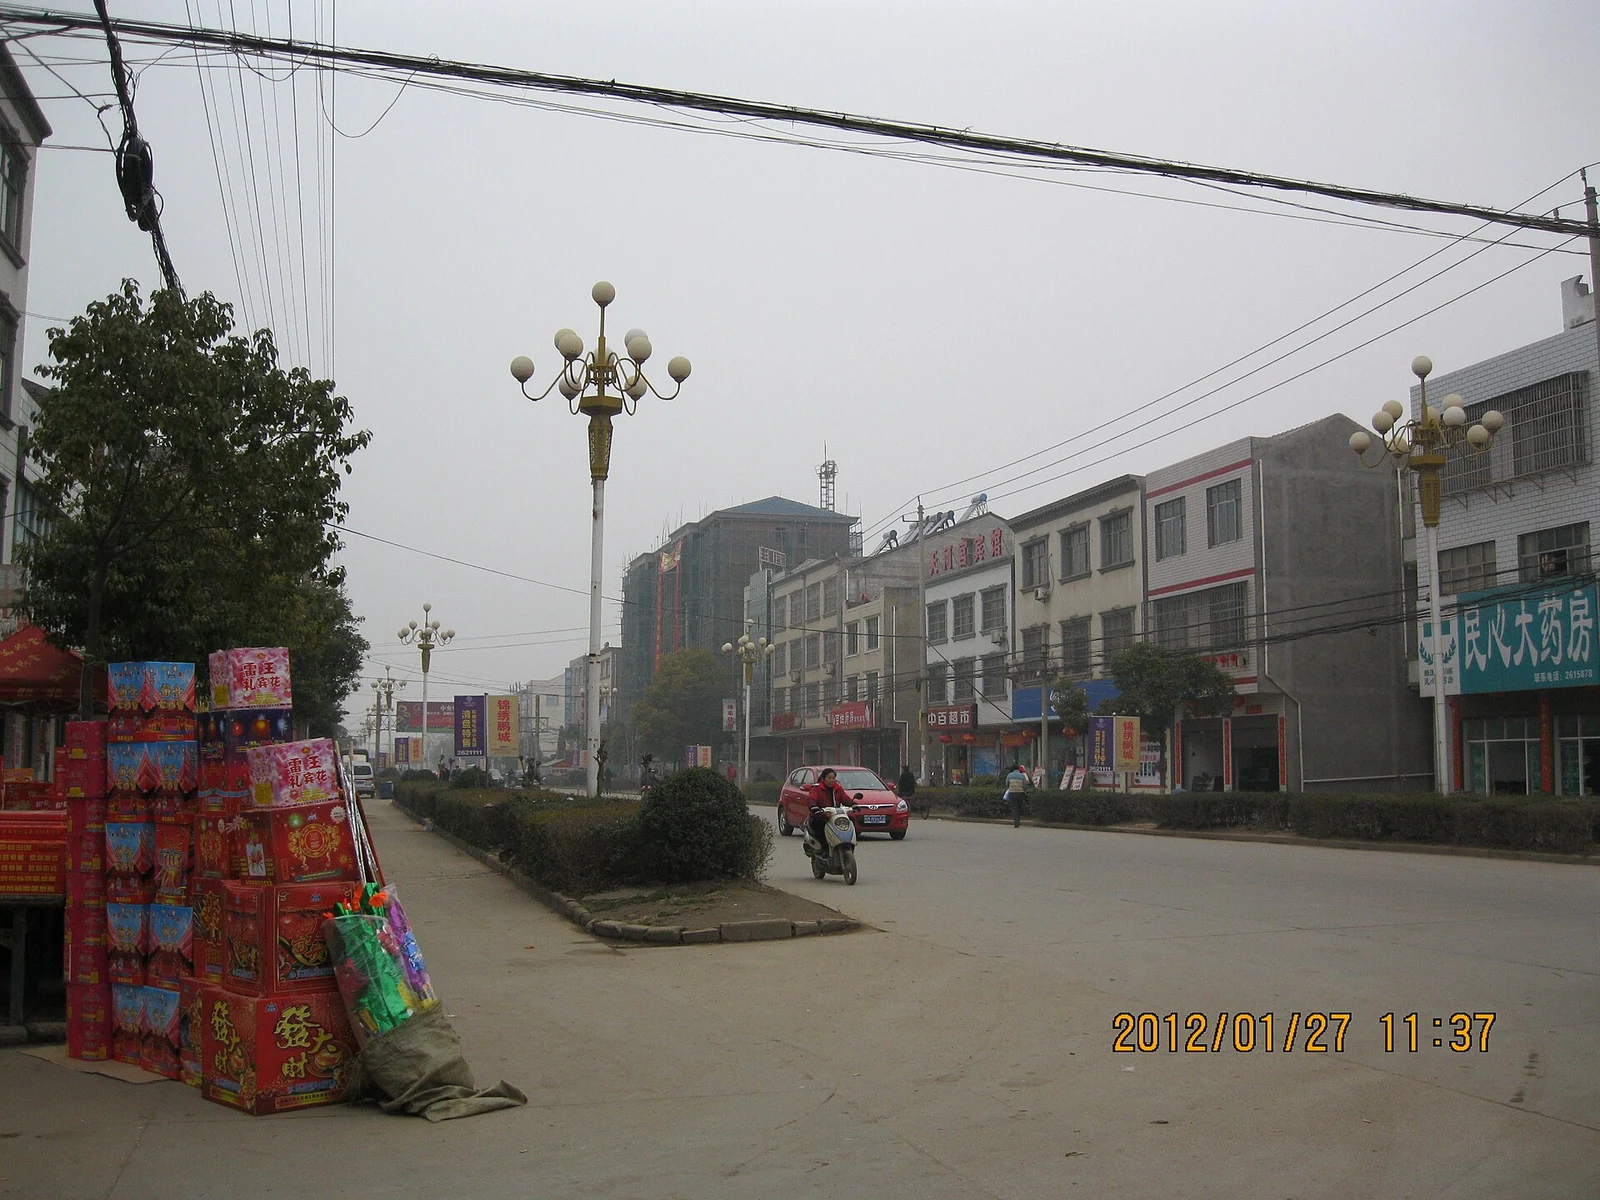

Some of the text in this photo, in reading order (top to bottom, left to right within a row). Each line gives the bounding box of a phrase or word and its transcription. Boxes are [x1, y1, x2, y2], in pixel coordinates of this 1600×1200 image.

[1464, 590, 1593, 672] 民心大药房
[243, 662, 276, 677] 雷王
[243, 676, 281, 691] 礼宾花
[497, 699, 511, 743] 锦绣鹏城
[927, 710, 970, 726] 中百超市
[288, 755, 322, 774] 雷王
[289, 770, 328, 789] 礼宾花
